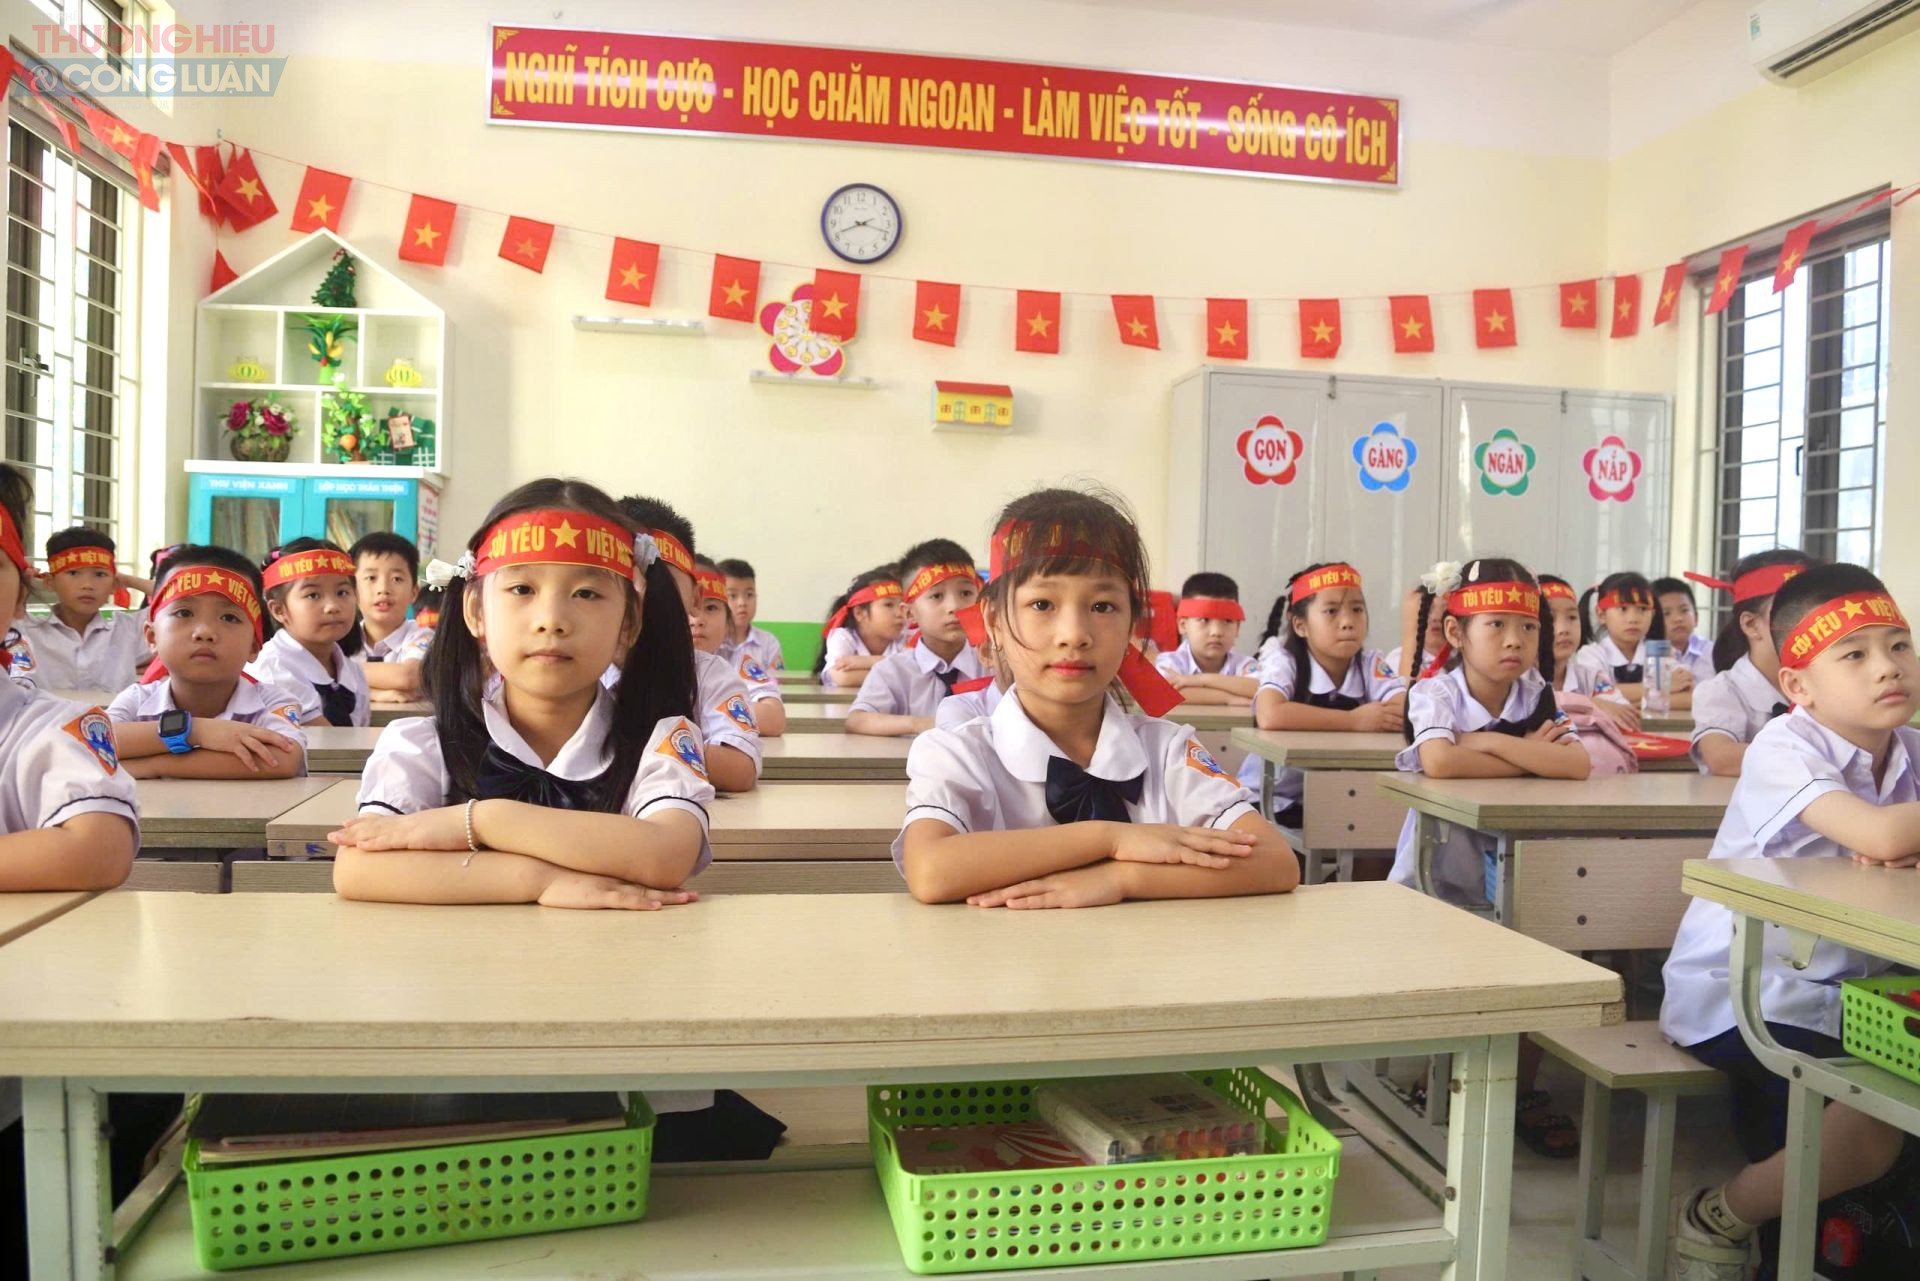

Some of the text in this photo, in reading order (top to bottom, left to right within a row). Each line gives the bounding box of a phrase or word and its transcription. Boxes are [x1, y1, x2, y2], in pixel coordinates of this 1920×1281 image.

[505, 44, 577, 105] NGHĨ
[584, 46, 647, 109] TÍCH
[657, 57, 714, 122] CỰC
[742, 65, 799, 128] HỌC
[809, 63, 890, 124] CHĂM
[900, 78, 995, 132] NGOAN
[1022, 78, 1080, 139] LÀM
[1089, 85, 1146, 154] VIỆC
[1155, 86, 1201, 150] TỐT
[1227, 93, 1296, 158] SỐNG
[1305, 106, 1338, 163] CÓ
[1346, 107, 1386, 166] ÍCH
[1255, 438, 1627, 481] GỌN GÀNG NGĂN NẮP
[258, 480, 289, 490] XANH
[511, 521, 545, 554] YÊU
[586, 526, 614, 563] VIỆT
[294, 558, 313, 574] YÊU
[1322, 570, 1340, 585] YÊU
[177, 572, 203, 593] YÊU
[229, 577, 249, 603] VIỆT
[1463, 588, 1478, 608] TÔI
[1480, 586, 1504, 606] YÊU
[1808, 610, 1842, 643] YÊU
